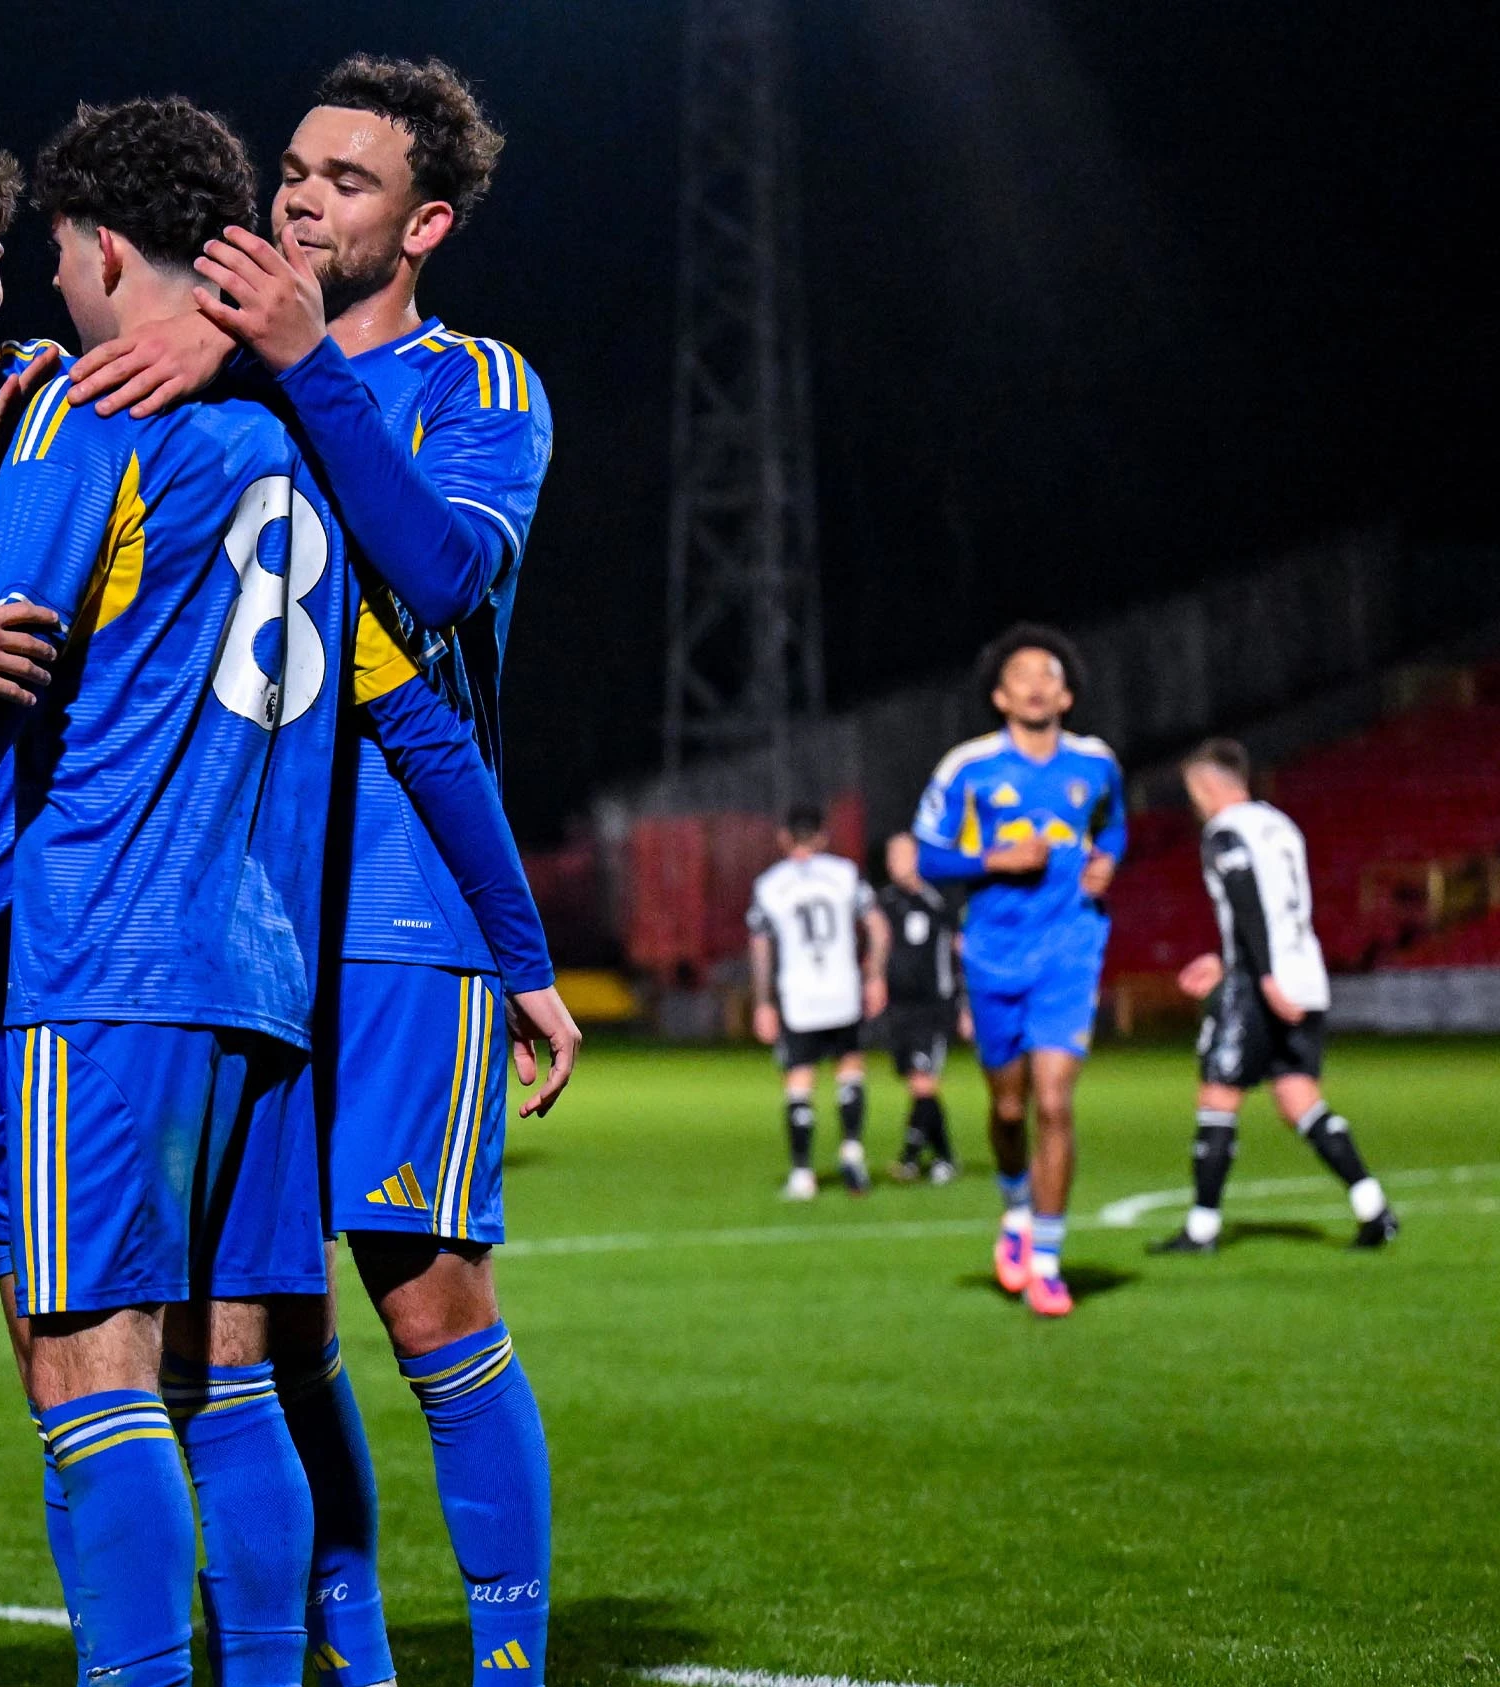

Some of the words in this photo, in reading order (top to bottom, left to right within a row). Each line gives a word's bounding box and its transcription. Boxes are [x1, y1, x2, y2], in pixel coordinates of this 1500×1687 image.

[212, 475, 329, 731] 8
[392, 919, 432, 929] AEROREADY
[795, 898, 838, 945] 10
[470, 1579, 541, 1603] LUFC
